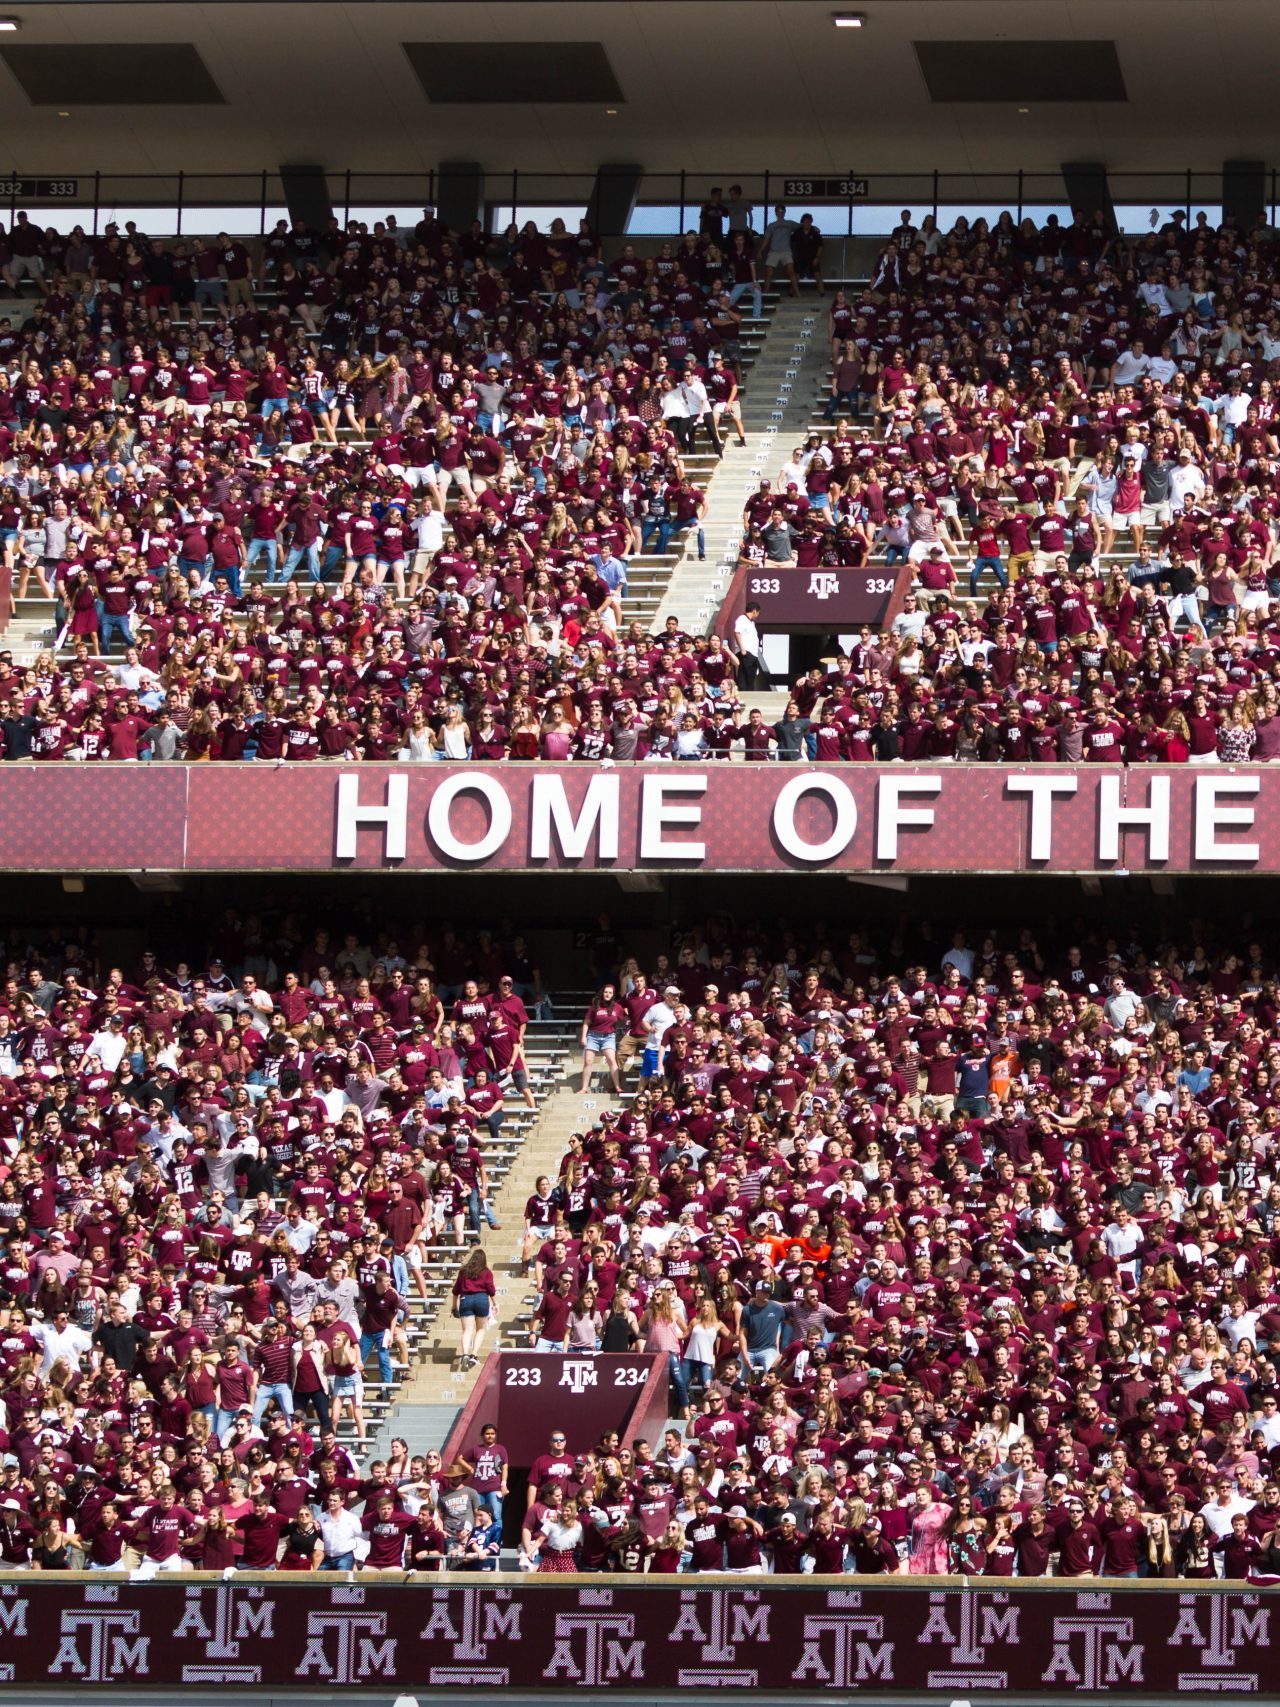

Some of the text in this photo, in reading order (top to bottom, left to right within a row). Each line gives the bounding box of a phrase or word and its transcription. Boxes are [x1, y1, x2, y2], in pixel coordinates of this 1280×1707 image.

[50, 182, 75, 195] 333
[788, 182, 813, 195] 333
[840, 182, 865, 195] 334
[901, 237, 910, 249] 12
[447, 291, 459, 303] 12
[304, 380, 317, 394] 12
[751, 579, 781, 594] 333
[866, 579, 896, 594] 334
[871, 693, 884, 708] 12
[83, 740, 98, 754] 12
[583, 739, 603, 758] 12
[336, 772, 707, 861] HOME
[774, 772, 942, 861] OF
[1007, 774, 1261, 860] THE
[174, 1173, 194, 1193] 12
[1237, 1168, 1256, 1189] 12
[569, 1196, 584, 1212] 12
[506, 1368, 542, 1385] 233
[615, 1368, 650, 1385] 234
